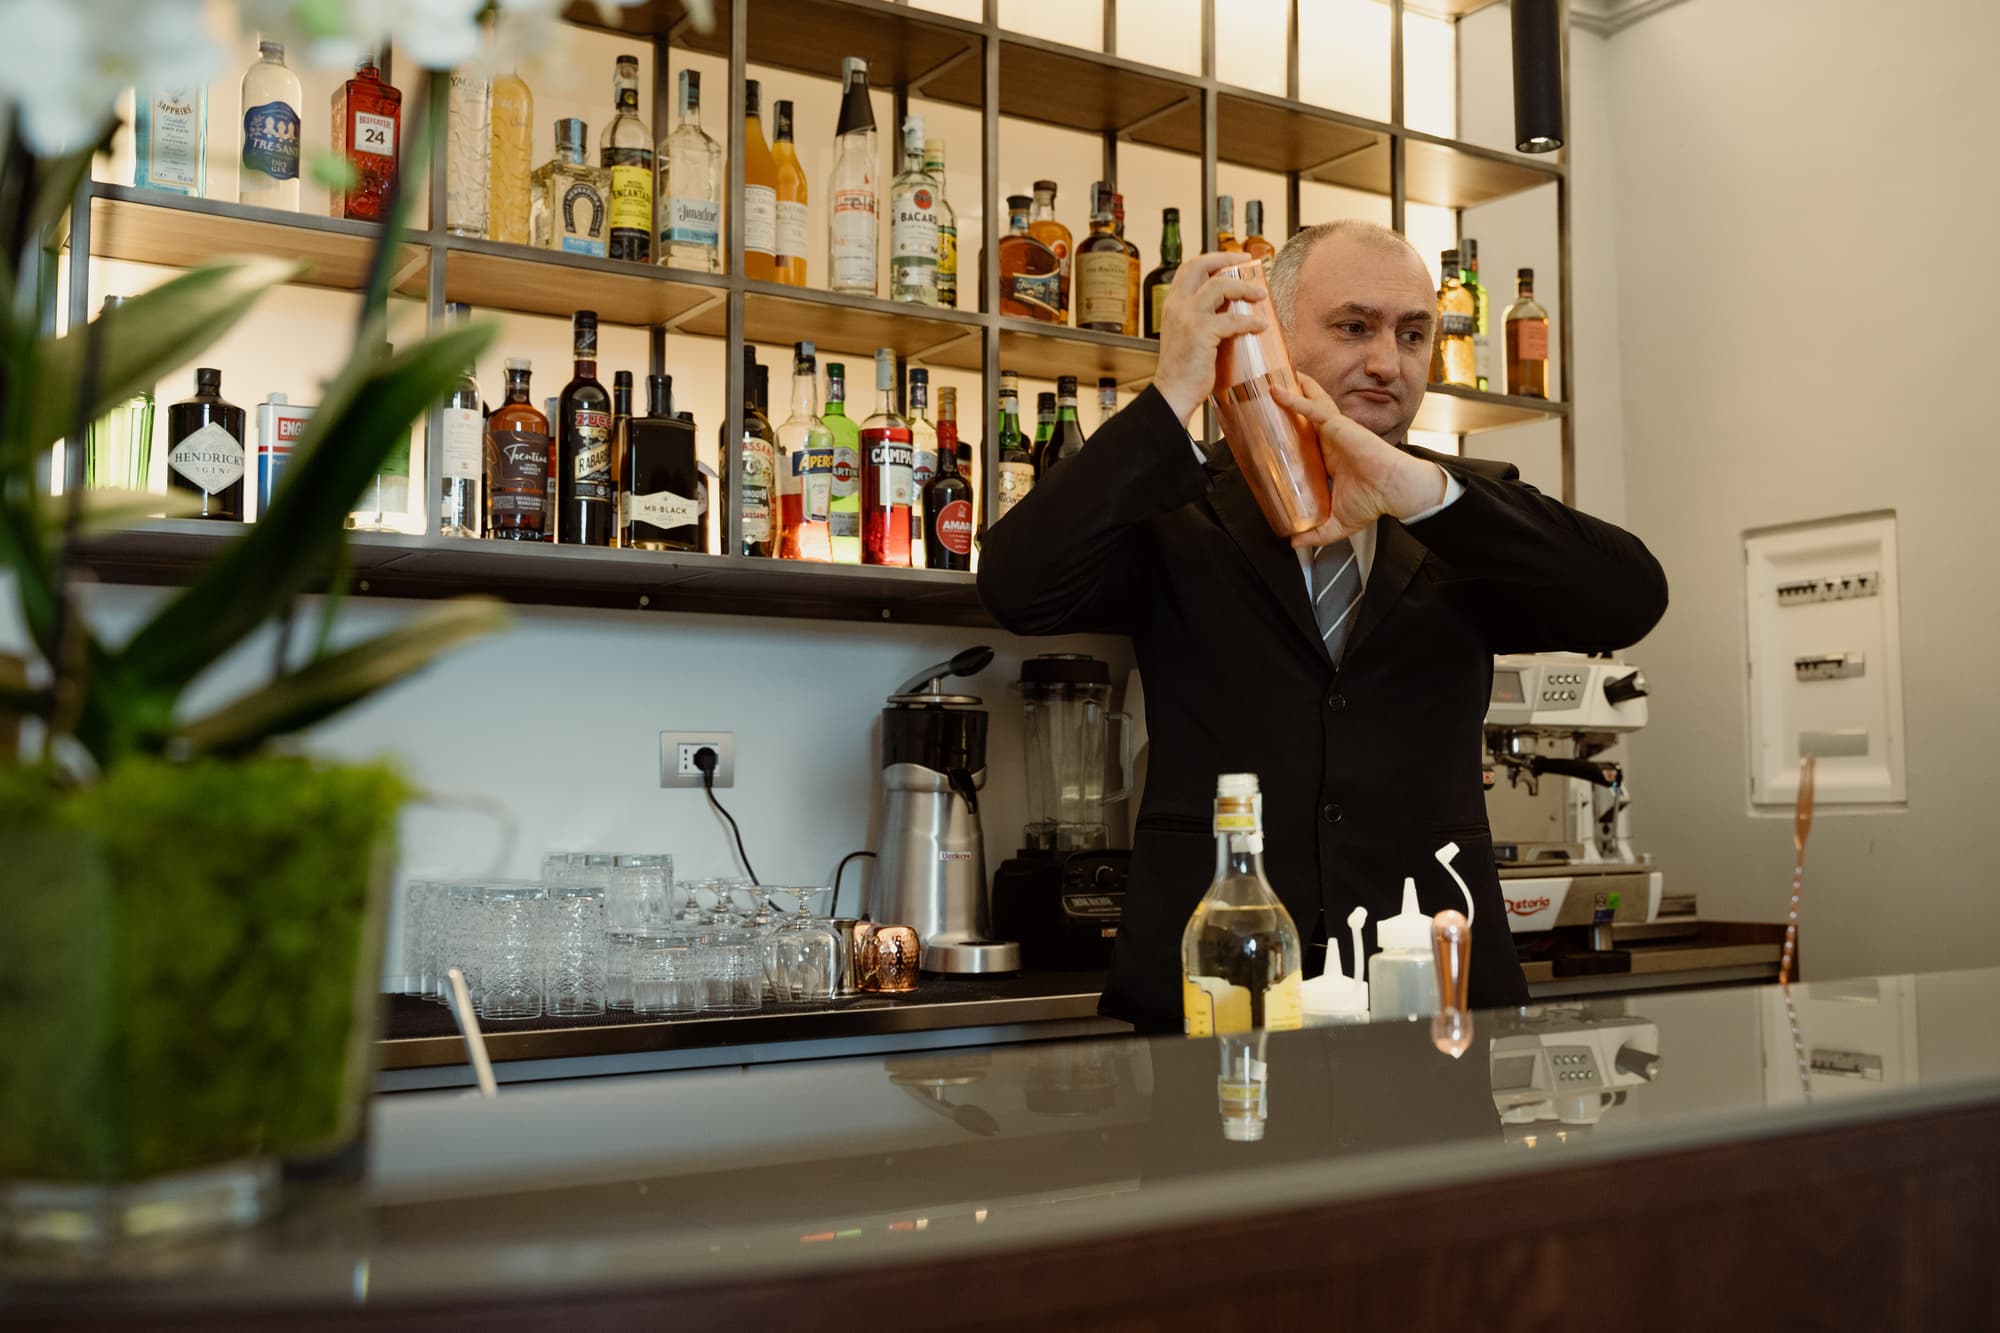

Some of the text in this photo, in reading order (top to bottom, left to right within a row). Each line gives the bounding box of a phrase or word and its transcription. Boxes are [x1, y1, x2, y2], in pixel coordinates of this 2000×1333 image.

[365, 128, 385, 145] 24
[271, 165, 287, 174] GIN
[679, 204, 717, 222] Jimador
[202, 466, 227, 475] GIN
[660, 505, 687, 515] BLACK
